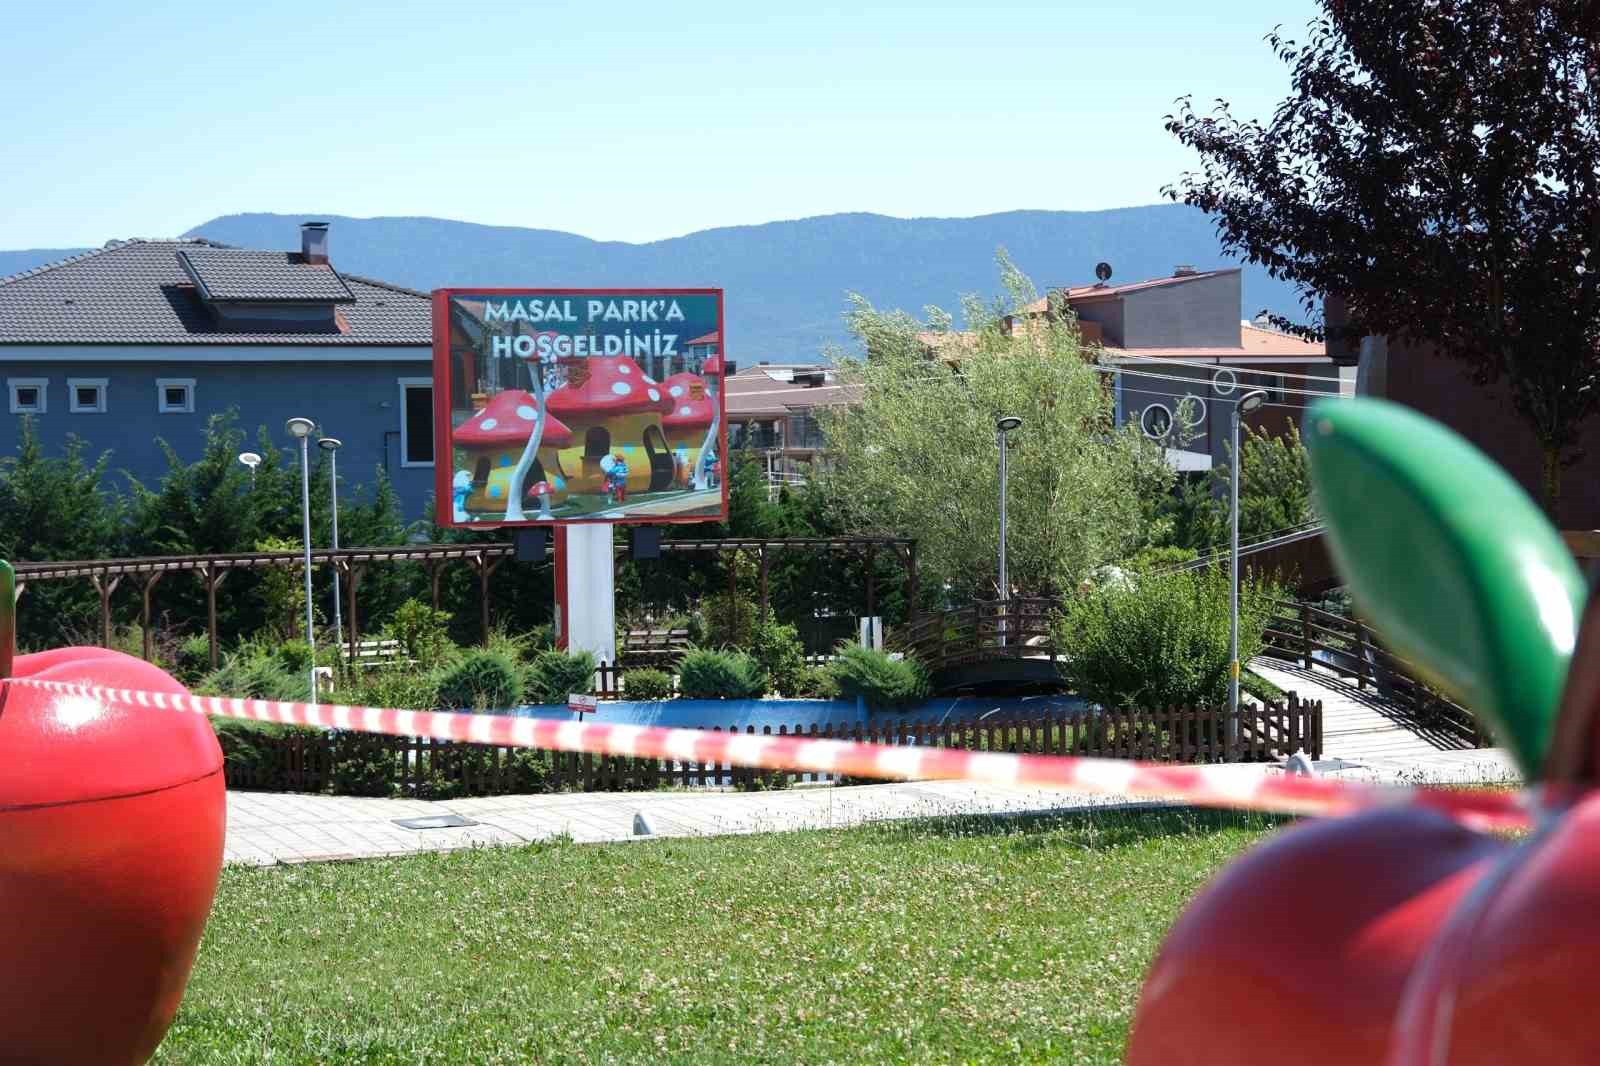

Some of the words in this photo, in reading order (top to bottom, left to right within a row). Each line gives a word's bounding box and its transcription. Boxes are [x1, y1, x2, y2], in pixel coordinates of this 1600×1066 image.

[484, 299, 578, 322] MASAL
[587, 299, 686, 322] PARK'A
[492, 328, 679, 364] HOŞGELDİNİZ
